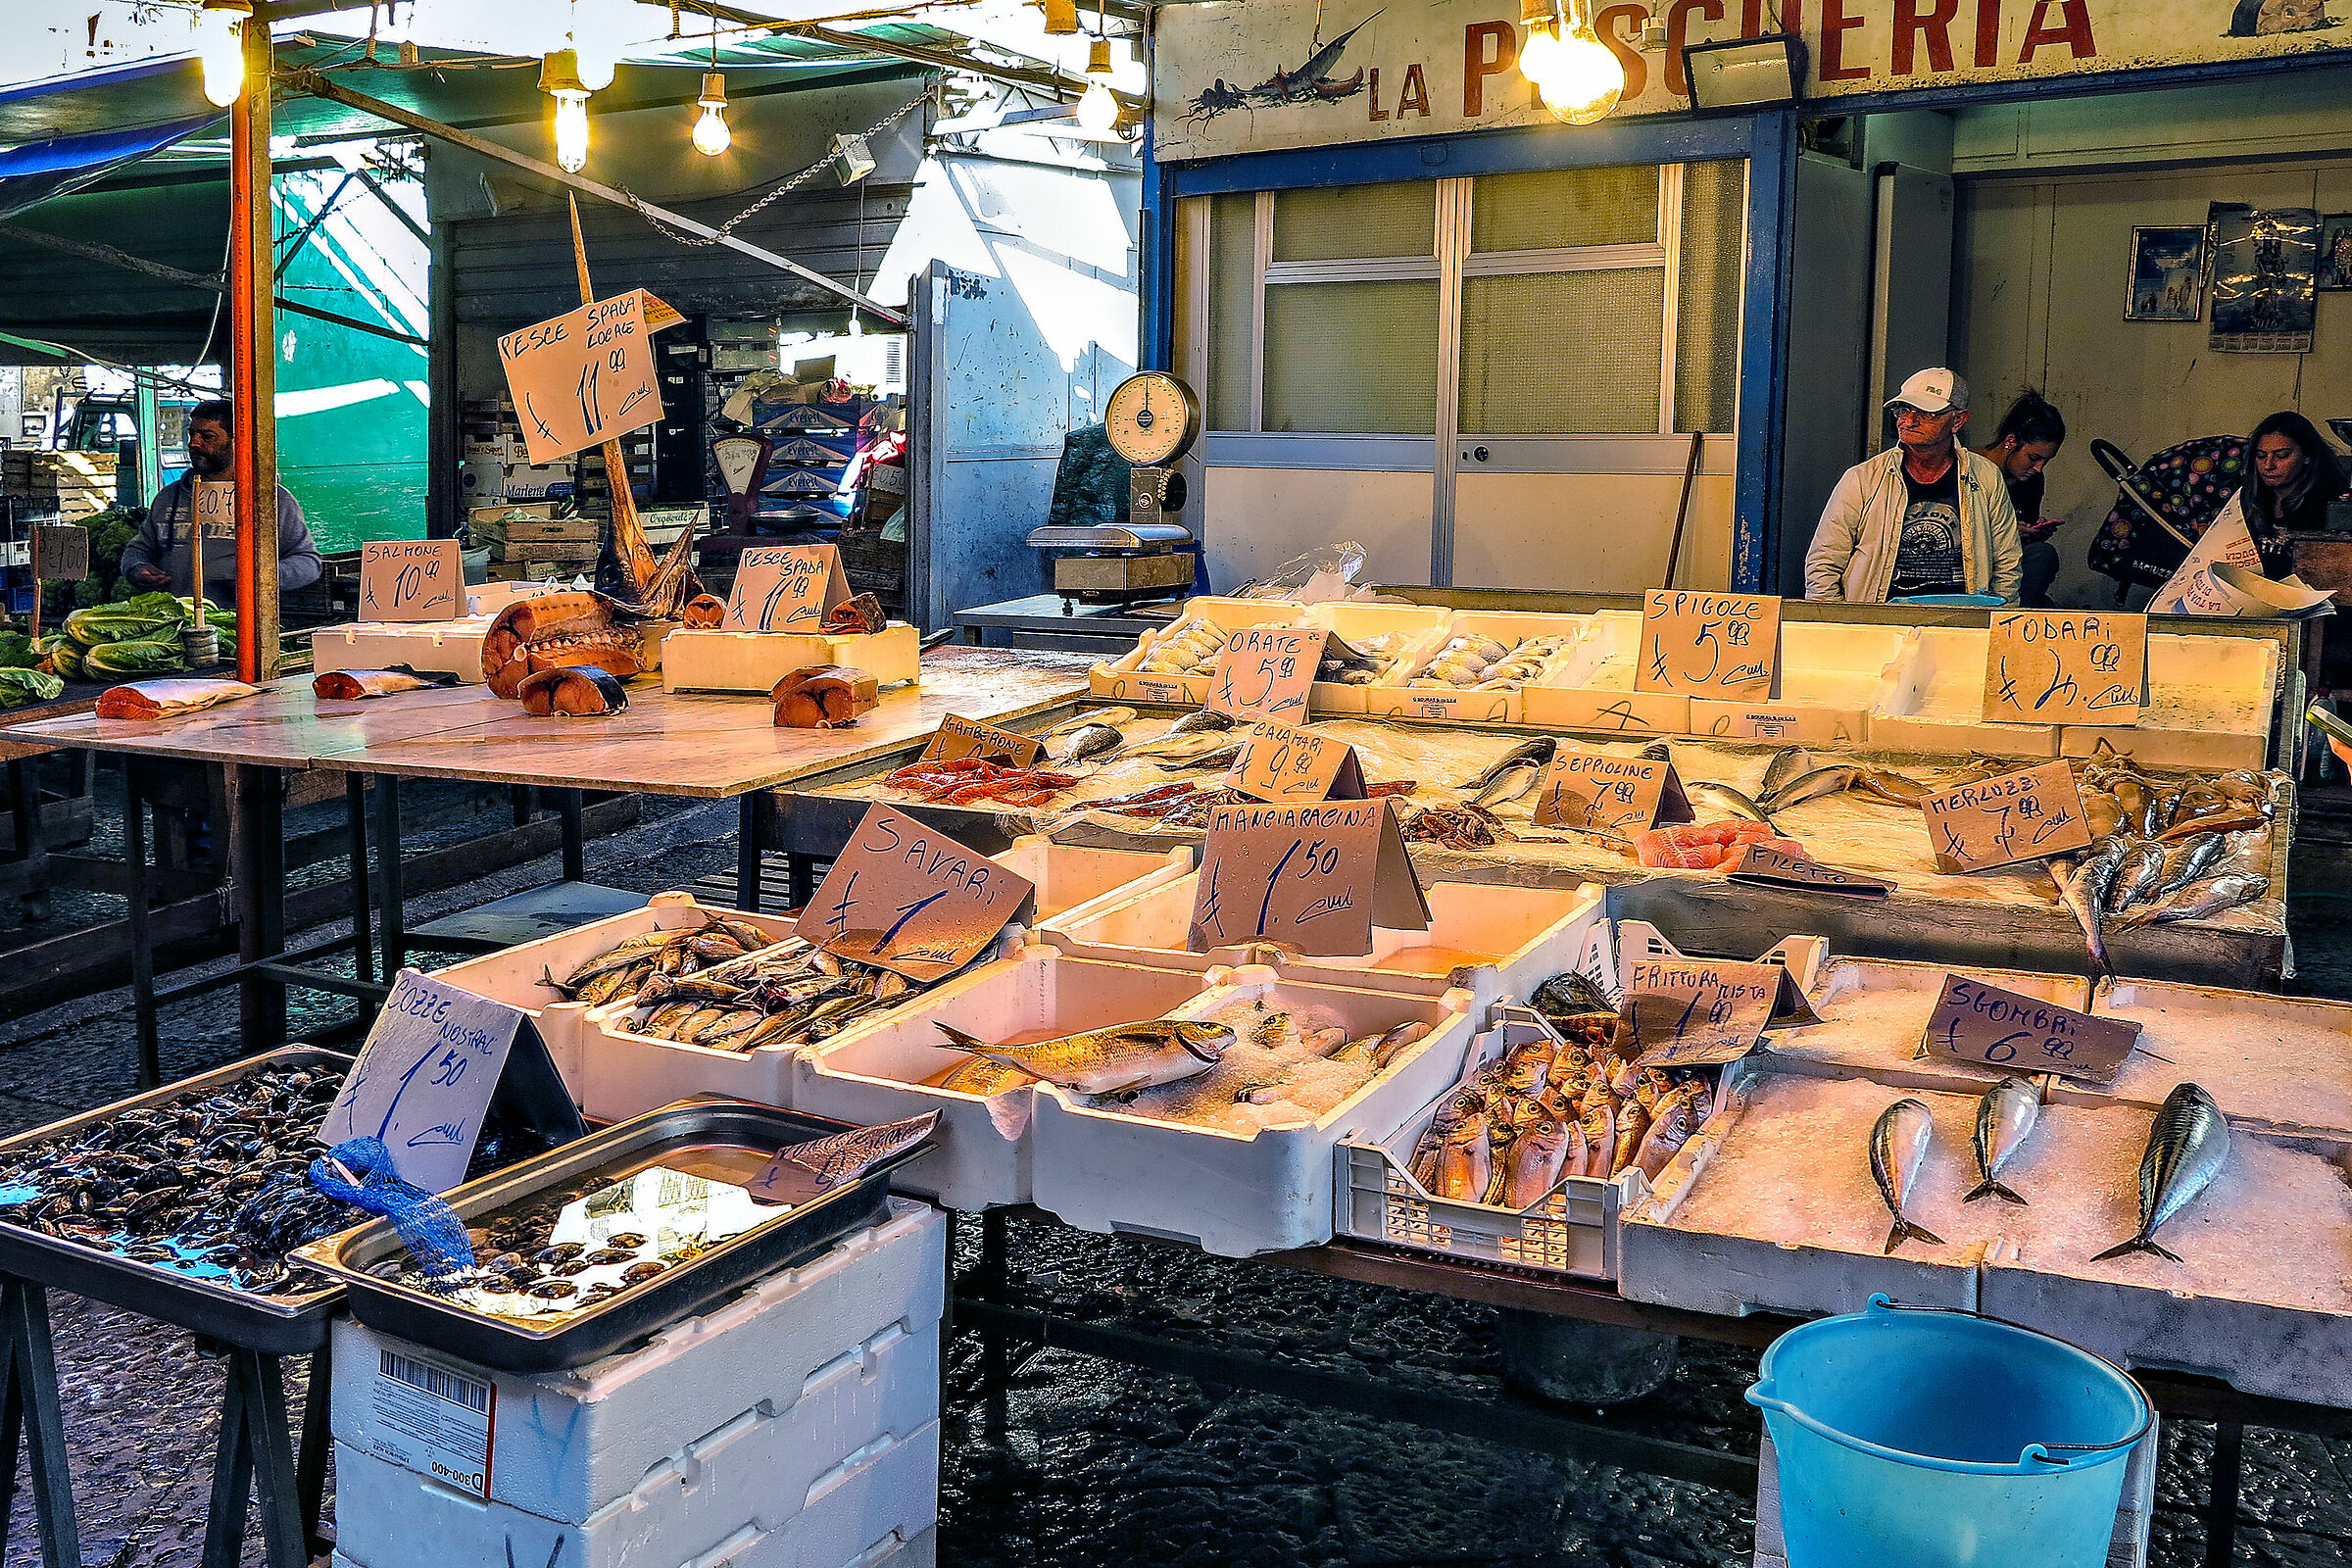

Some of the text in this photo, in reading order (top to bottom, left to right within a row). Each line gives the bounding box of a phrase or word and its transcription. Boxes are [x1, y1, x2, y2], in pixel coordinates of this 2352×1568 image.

[1369, 0, 2097, 122] LA PSCERIA
[501, 297, 635, 361] PESCE SPADA
[588, 321, 635, 349] LOCALE
[790, 411, 821, 423] Everest
[788, 443, 818, 456] Everest
[506, 484, 545, 497] Marlene
[788, 474, 817, 487] Everest
[367, 545, 442, 563] SALMONE
[744, 550, 793, 567] PESCE
[780, 559, 824, 576] SPADA
[1648, 593, 1762, 619] SPIGOLE
[1229, 631, 1301, 653] ORATE
[945, 716, 1027, 757] GAMBERONE
[1752, 848, 1847, 884] FILETTO
[1633, 965, 1765, 1000] FRITTURA MISTA
[386, 979, 452, 1023] COZZE
